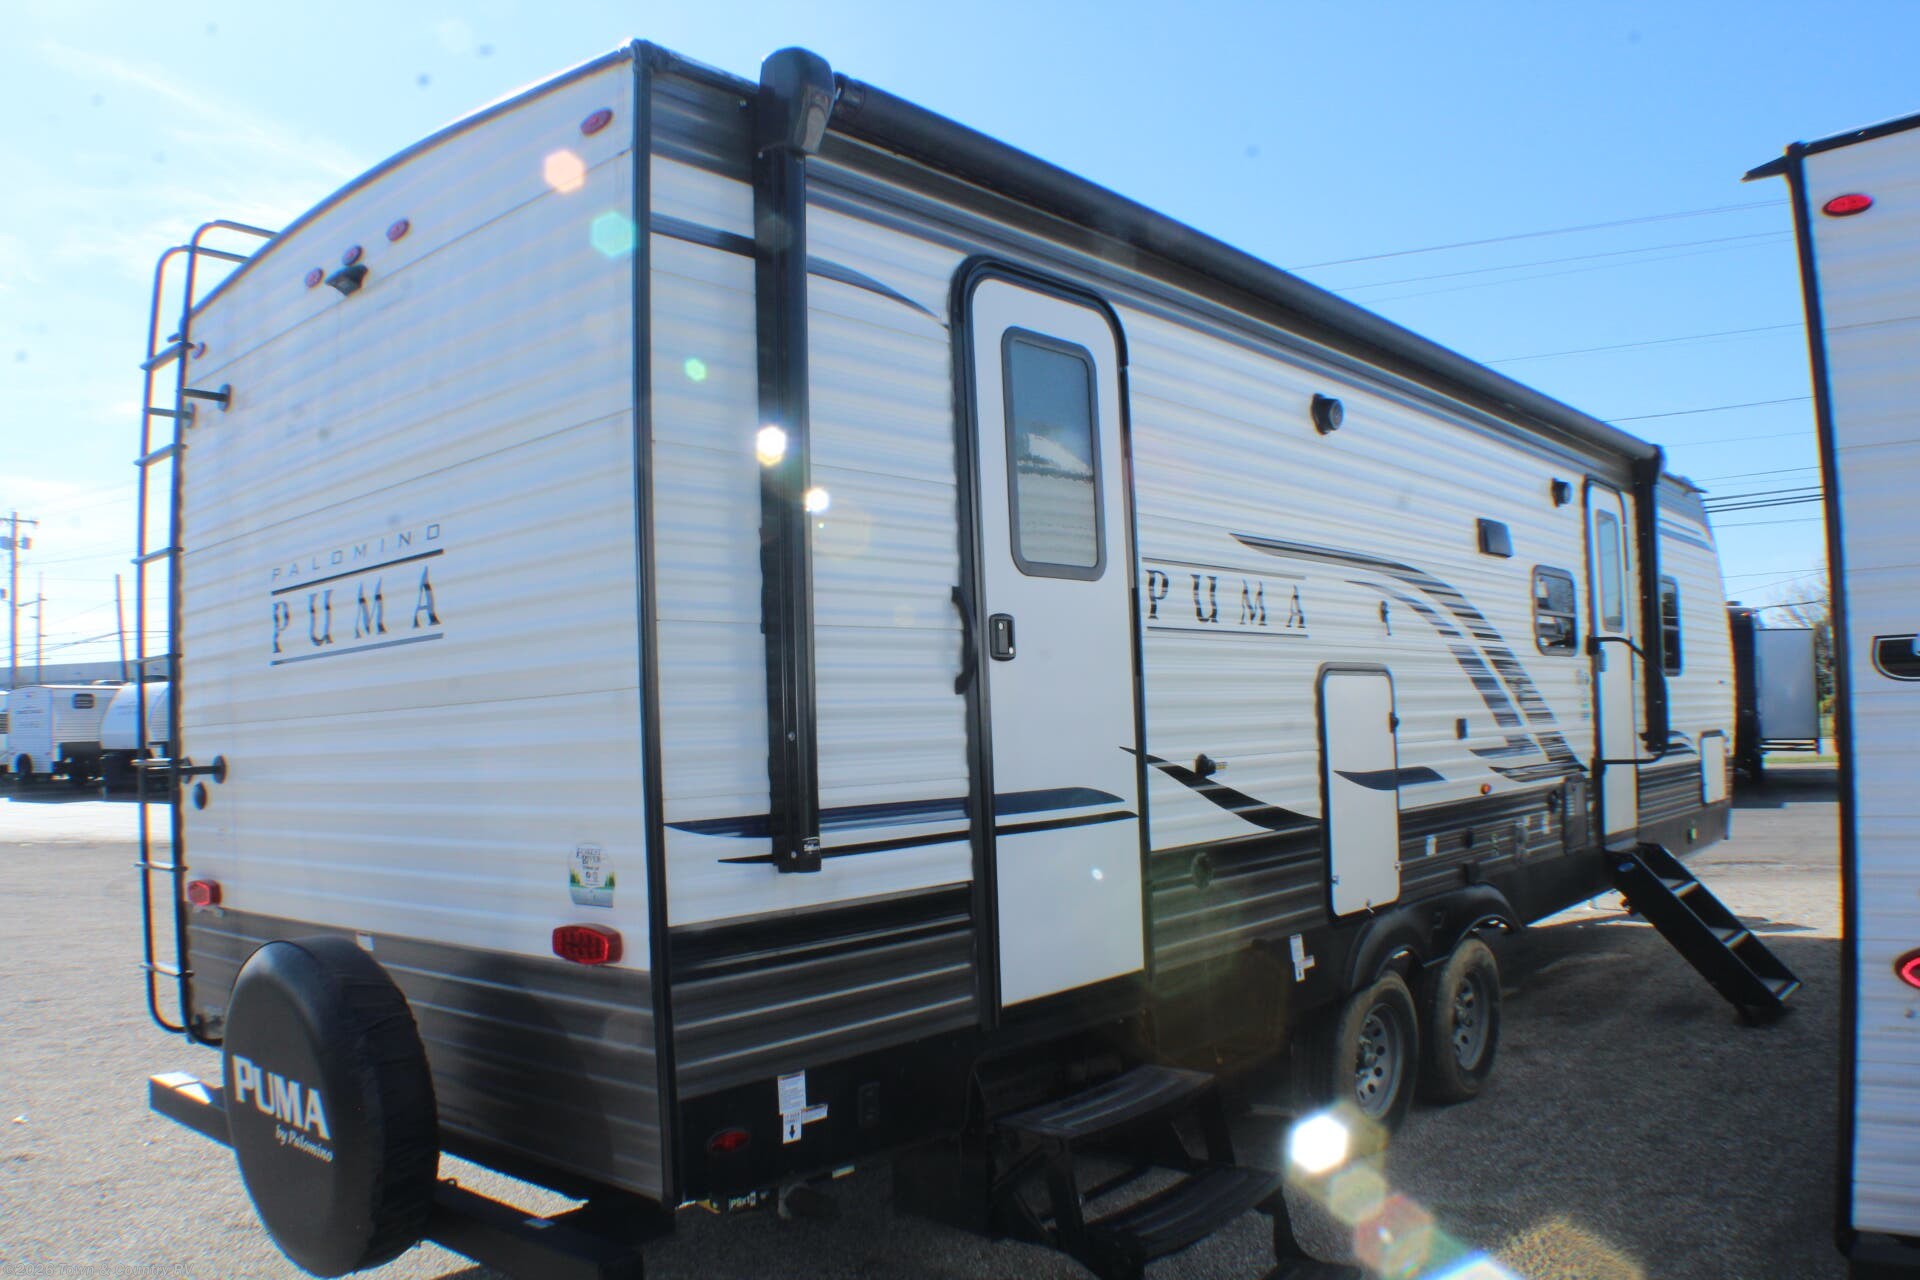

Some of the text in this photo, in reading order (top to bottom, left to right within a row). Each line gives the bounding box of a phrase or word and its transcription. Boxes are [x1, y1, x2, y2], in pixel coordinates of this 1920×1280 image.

[271, 523, 441, 582] PALOMINO
[271, 564, 442, 654] PUMA
[1145, 569, 1307, 629] PUMA
[231, 1054, 332, 1141] PUMA
[274, 1123, 334, 1163] by Palomino
